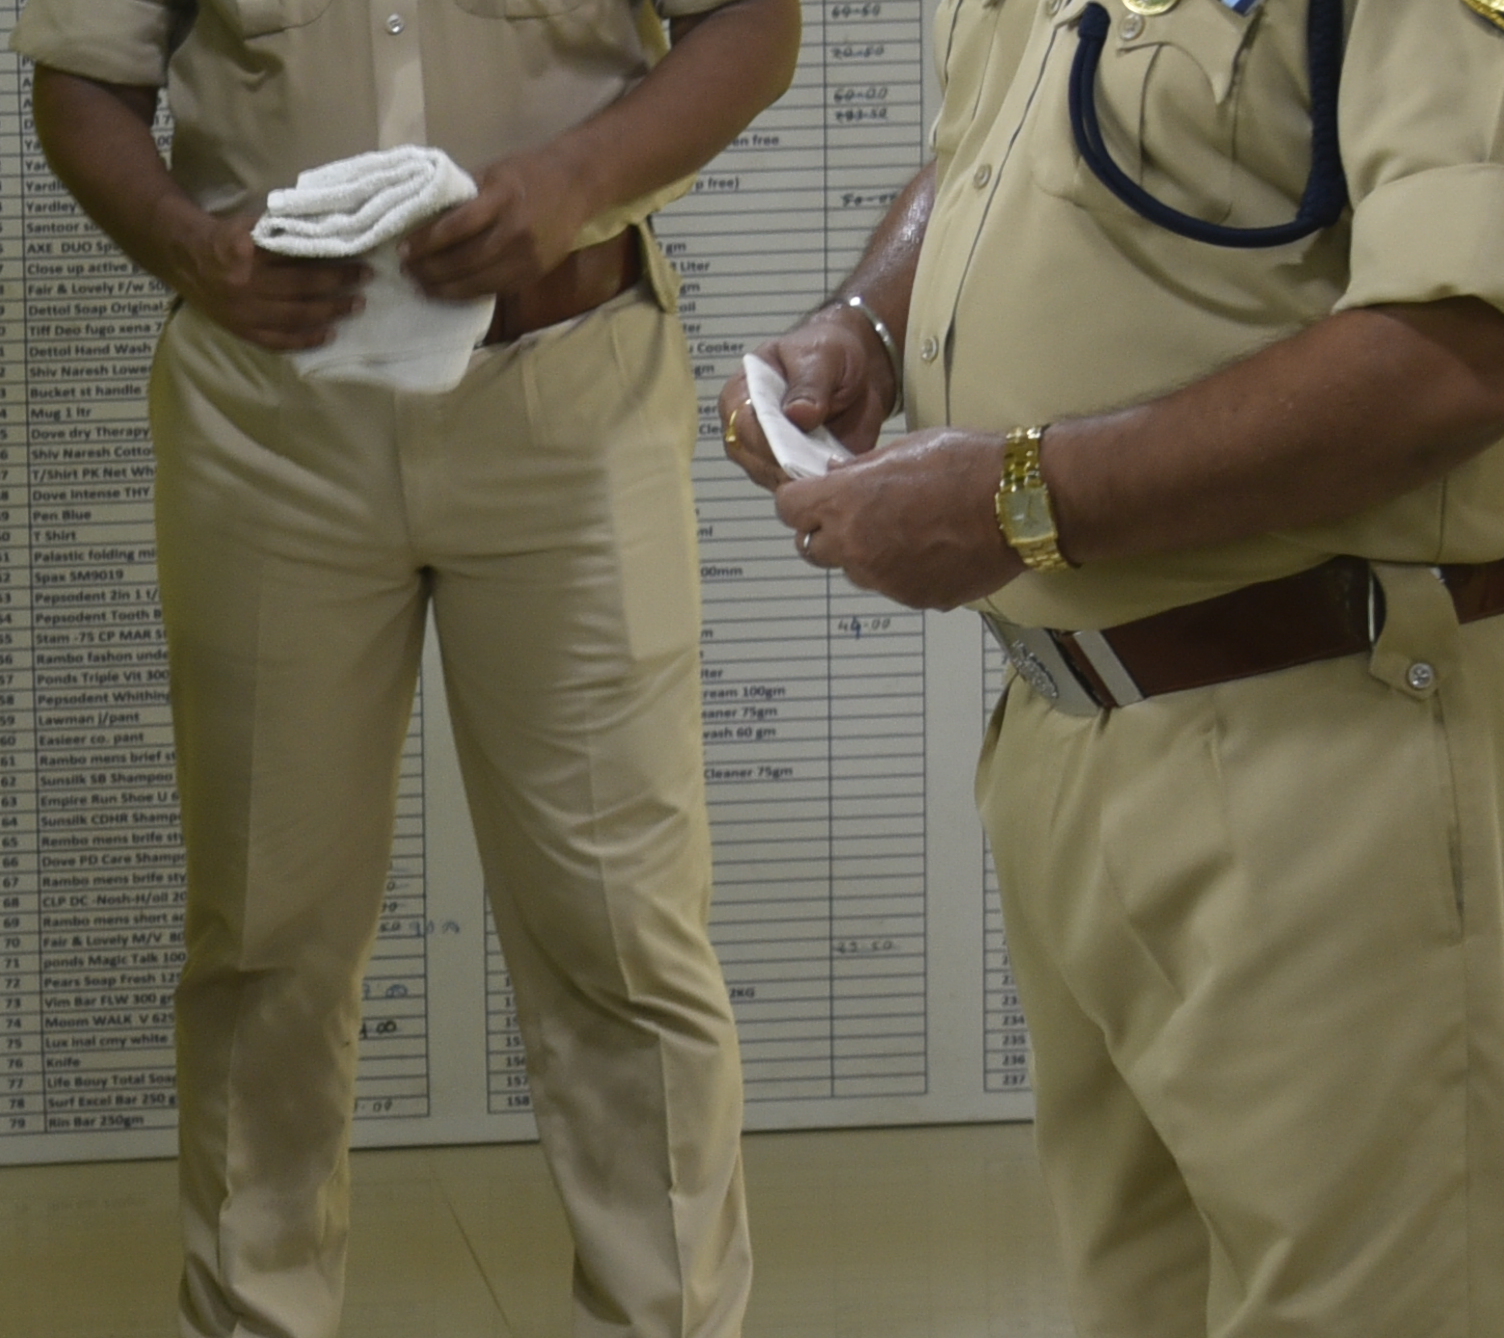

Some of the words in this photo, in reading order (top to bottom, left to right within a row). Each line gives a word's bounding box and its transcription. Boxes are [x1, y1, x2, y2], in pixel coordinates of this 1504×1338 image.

[26, 200, 75, 215] Yardley
[27, 221, 79, 233] Santoor
[28, 263, 63, 274] Close
[66, 261, 85, 276] up
[87, 261, 127, 272] active
[28, 283, 52, 295] Fair
[71, 282, 114, 297] Lovely
[29, 304, 71, 316] Dettol
[74, 302, 107, 317] Soap
[30, 345, 71, 357] Dettol
[74, 344, 110, 355] Hand
[113, 342, 151, 354] Wash
[696, 341, 745, 354] Cooker
[31, 386, 75, 398] Bucket
[79, 386, 91, 396] st
[95, 383, 141, 396] handle
[31, 407, 61, 421] Mug
[65, 407, 72, 417] 1
[76, 406, 91, 417] ltr
[32, 428, 67, 439] Dove
[68, 426, 93, 441] dry
[94, 424, 150, 440] Therapy
[35, 571, 66, 585] Spax
[37, 672, 78, 685] Ponds
[81, 670, 120, 686] Triple
[742, 684, 786, 699] 100gm
[38, 714, 94, 726] Lawman
[112, 732, 144, 745] pant
[40, 774, 86, 786] Sunsilk
[110, 770, 173, 786] Shampoo
[757, 765, 793, 781] 75gm
[46, 1056, 81, 1068] Knife
[47, 1076, 71, 1088] Life
[74, 1075, 108, 1090] Bouy
[110, 1073, 145, 1085] Total
[48, 1117, 70, 1128] Rin
[73, 1115, 96, 1127] Bar
[100, 1113, 144, 1128] 250gm
